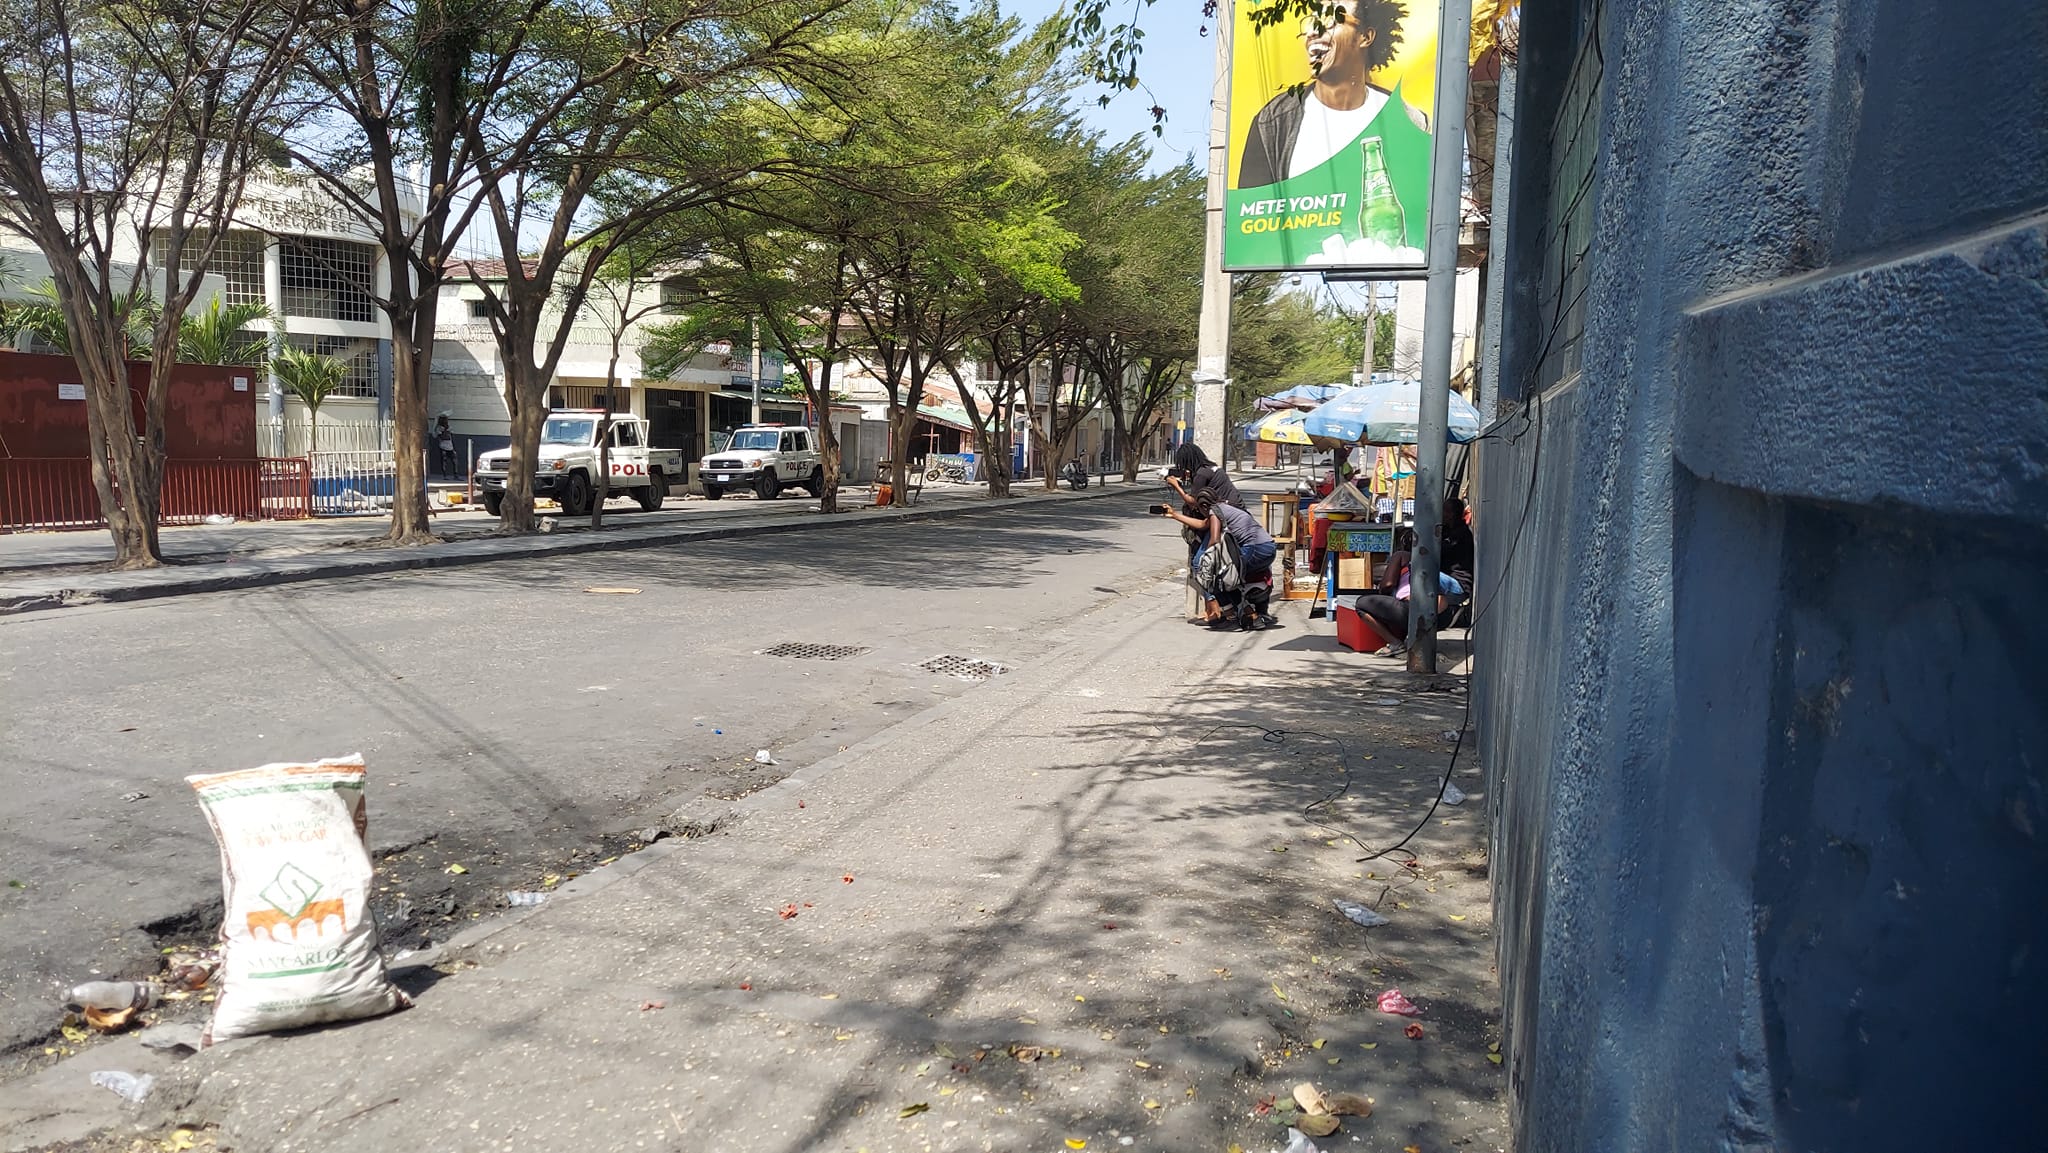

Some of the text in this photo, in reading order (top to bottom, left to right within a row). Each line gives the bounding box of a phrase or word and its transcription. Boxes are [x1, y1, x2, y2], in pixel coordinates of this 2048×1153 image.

[1240, 193, 1347, 216] METE YON TI
[331, 220, 352, 233] EST
[1241, 211, 1342, 234] GOU ANPLIS
